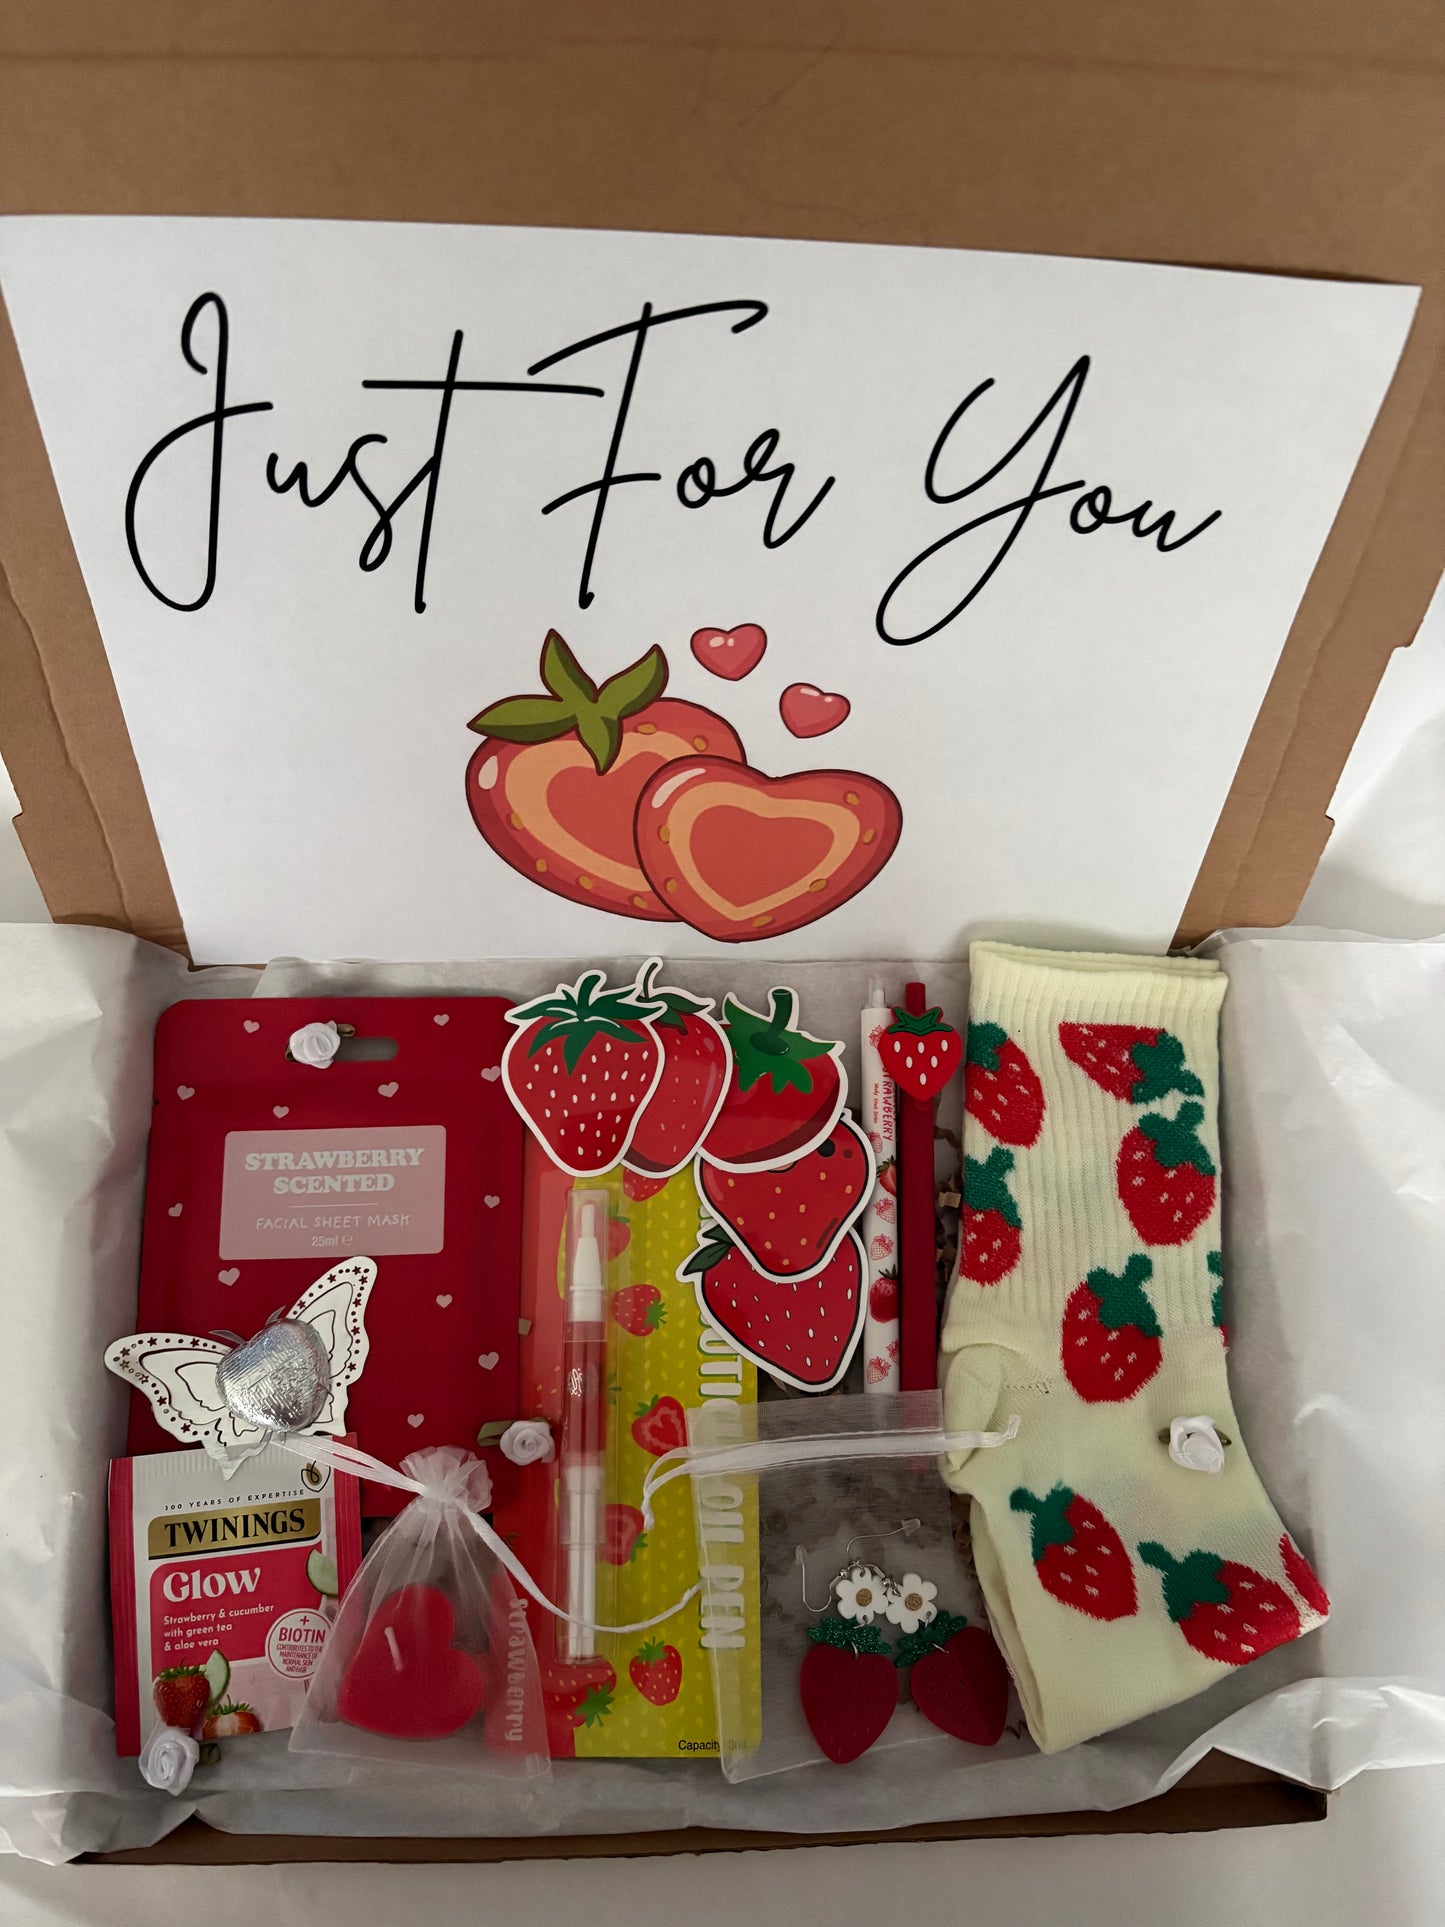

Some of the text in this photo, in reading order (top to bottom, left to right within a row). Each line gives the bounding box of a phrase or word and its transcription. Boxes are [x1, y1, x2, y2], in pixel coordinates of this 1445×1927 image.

[125, 290, 1223, 646] Just For You
[245, 1148, 425, 1171] STRAWBERRY
[273, 1173, 396, 1195] SCENTED
[255, 1213, 412, 1231] FACIAL SHEET MASK
[311, 1234, 339, 1247] 25ml
[164, 1488, 305, 1511] 300 YEARS OF EXPERTISE
[164, 1507, 306, 1548] TWININGS
[162, 1567, 262, 1603] Glow
[163, 1602, 275, 1626] Strawberry & cucumber
[700, 1564, 746, 1649] PEN
[163, 1623, 233, 1638] with green tea
[279, 1627, 325, 1643] BIOTIN
[163, 1637, 220, 1652] & aloe vera
